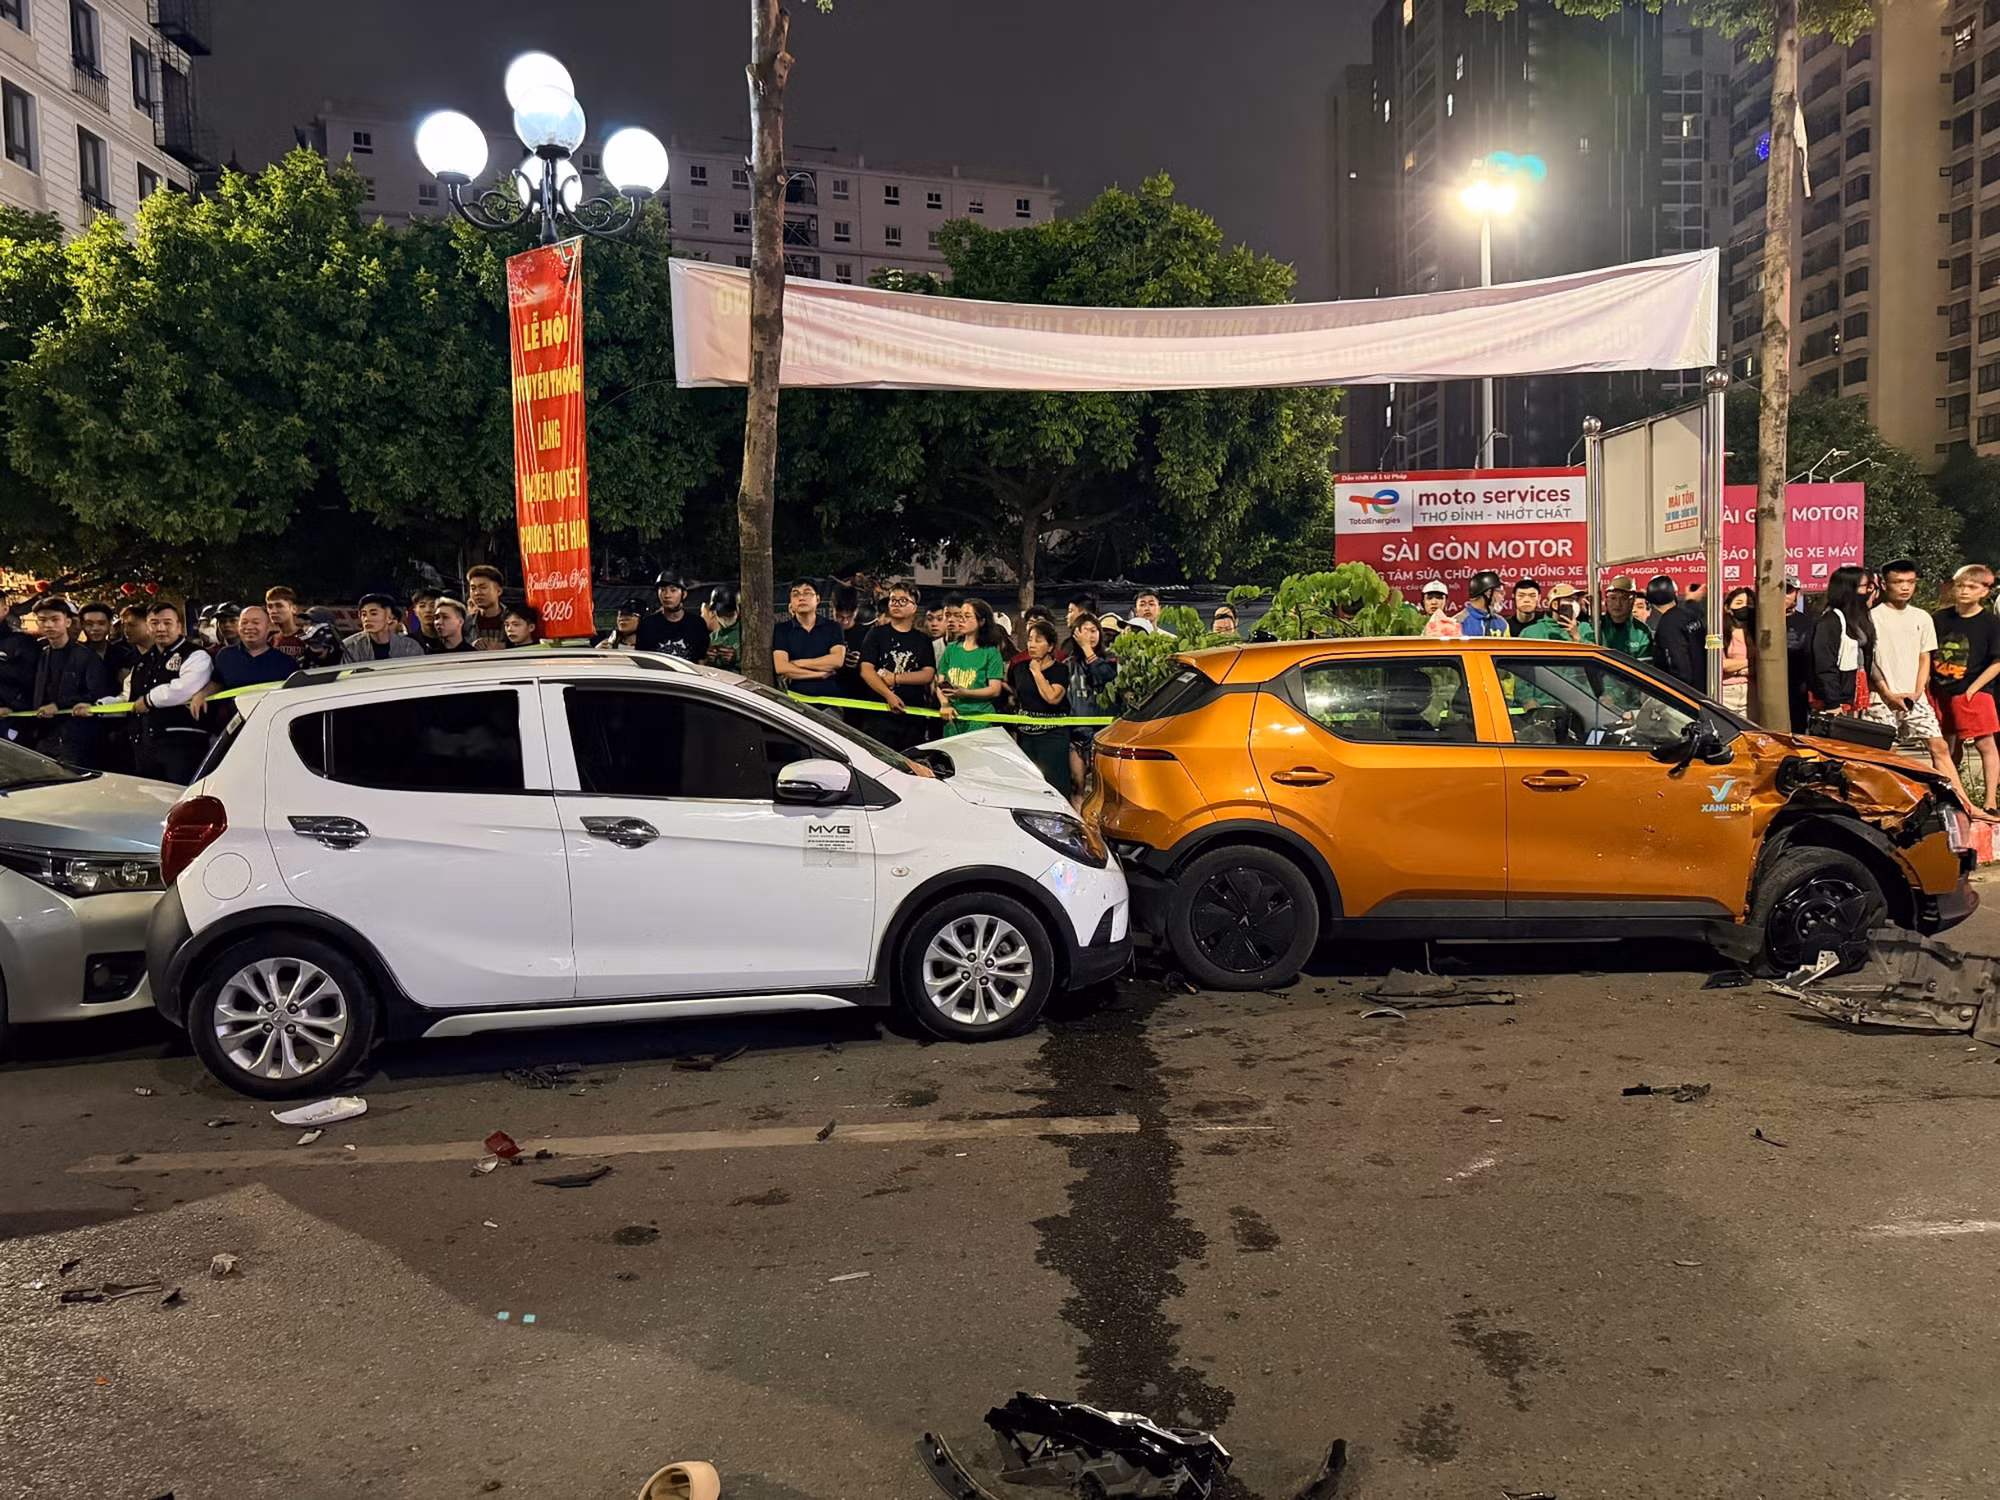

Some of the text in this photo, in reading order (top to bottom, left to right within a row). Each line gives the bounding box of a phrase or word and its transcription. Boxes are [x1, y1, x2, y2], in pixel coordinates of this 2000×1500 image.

[523, 310, 569, 352] LỄ HỘI
[538, 415, 561, 451] LÀNG
[1418, 485, 1571, 506] moto services
[1349, 517, 1401, 525] TotalEnergies
[1420, 511, 1448, 524] THỢ
[1496, 506, 1534, 520] NHỚT
[1536, 503, 1572, 519] CHẤT
[1722, 505, 1740, 524] ÀI
[1791, 506, 1859, 522] MOTOR
[1382, 534, 1573, 562] SÀI GÒN MOTOR
[1806, 546, 1825, 558] XE
[1828, 542, 1859, 558] MÁY
[1387, 567, 1414, 581] TÂM
[1416, 564, 1442, 581] SỬA
[1446, 563, 1480, 579] CHỮA
[1520, 564, 1565, 577] DƯỠNG
[1568, 566, 1584, 576] XE
[1625, 566, 1659, 574] PIAGGIO
[1665, 566, 1682, 574] SYM
[543, 597, 574, 621] 2026
[1701, 803, 1745, 812] XANH SM
[808, 825, 851, 834] MVG
